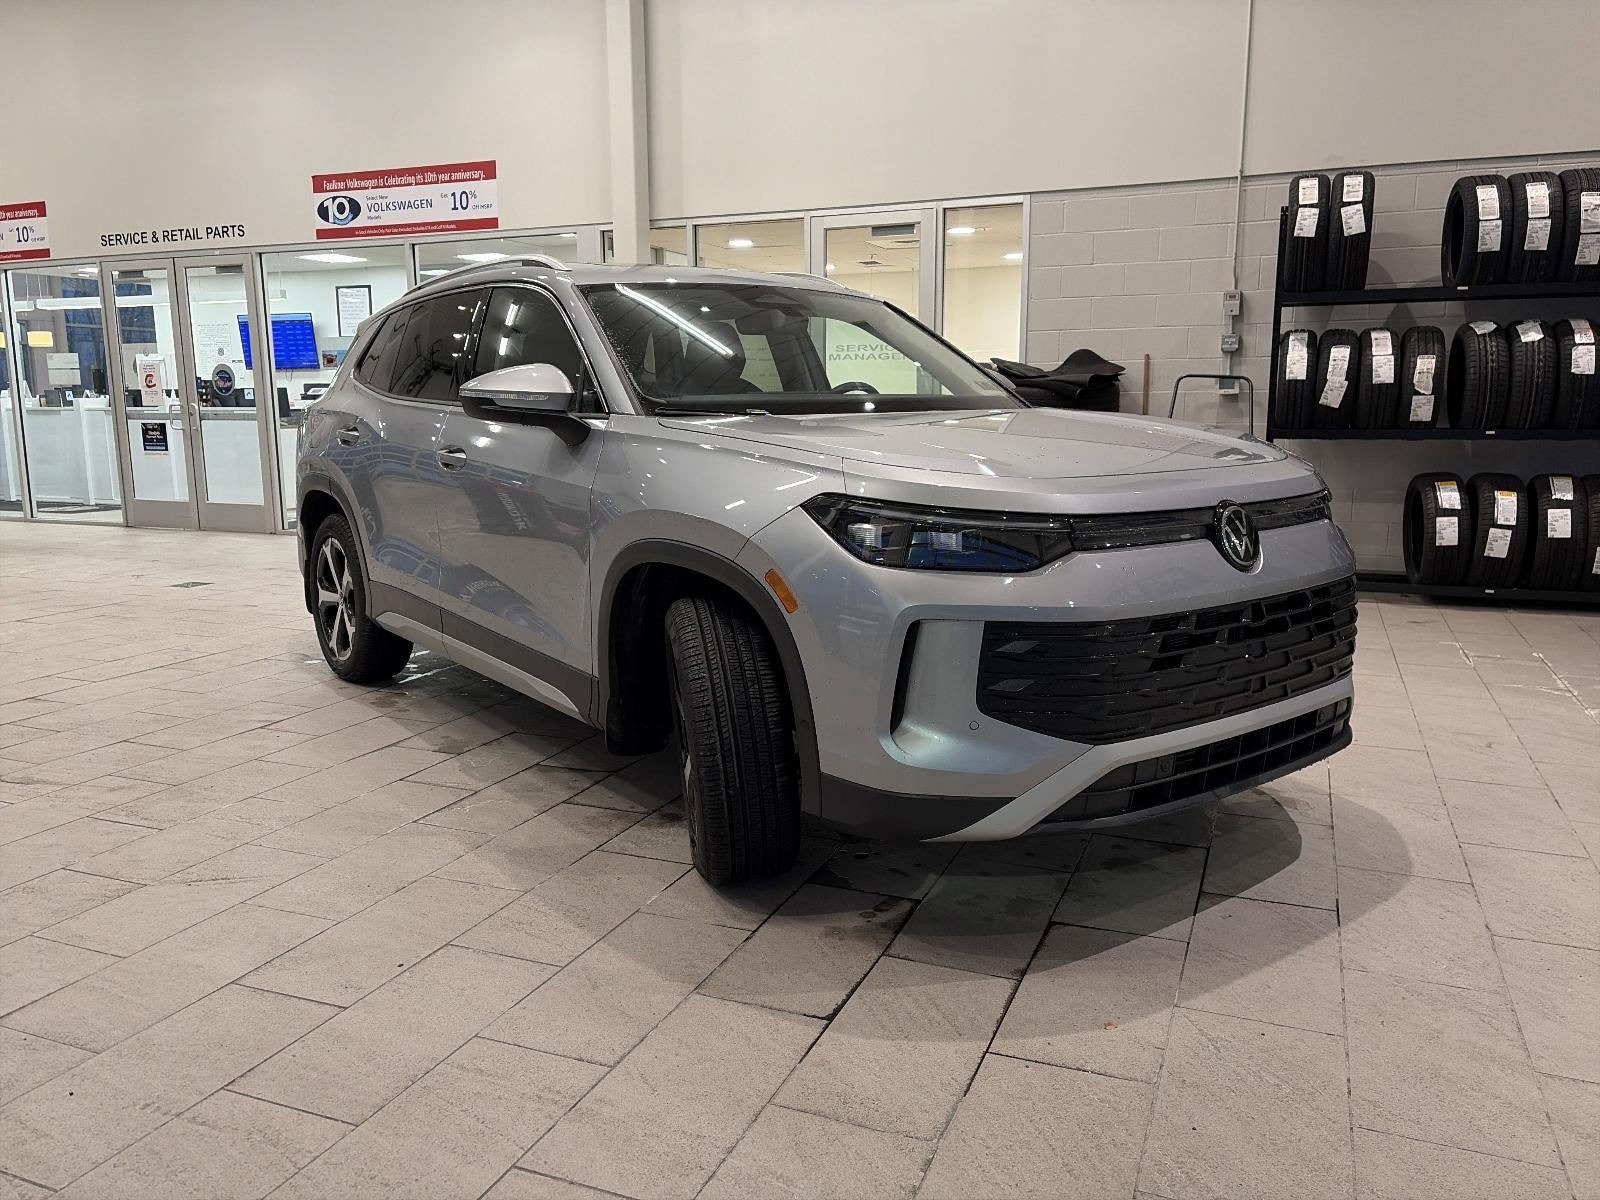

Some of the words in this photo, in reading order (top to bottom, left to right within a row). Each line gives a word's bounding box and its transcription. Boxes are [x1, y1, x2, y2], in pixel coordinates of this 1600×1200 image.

[346, 178, 378, 190] Volkswagen
[378, 176, 384, 186] is
[384, 174, 415, 186] Celebrating
[424, 171, 438, 183] 10th
[438, 172, 450, 184] year
[450, 169, 486, 181] anniversary.
[323, 197, 350, 223] 10
[366, 198, 433, 213] VOLKSWAGEN
[100, 231, 149, 247] SERVICE
[151, 230, 160, 243] &
[162, 227, 204, 243] RETAIL
[205, 224, 246, 239] PARTS
[835, 344, 896, 352] SERVIC
